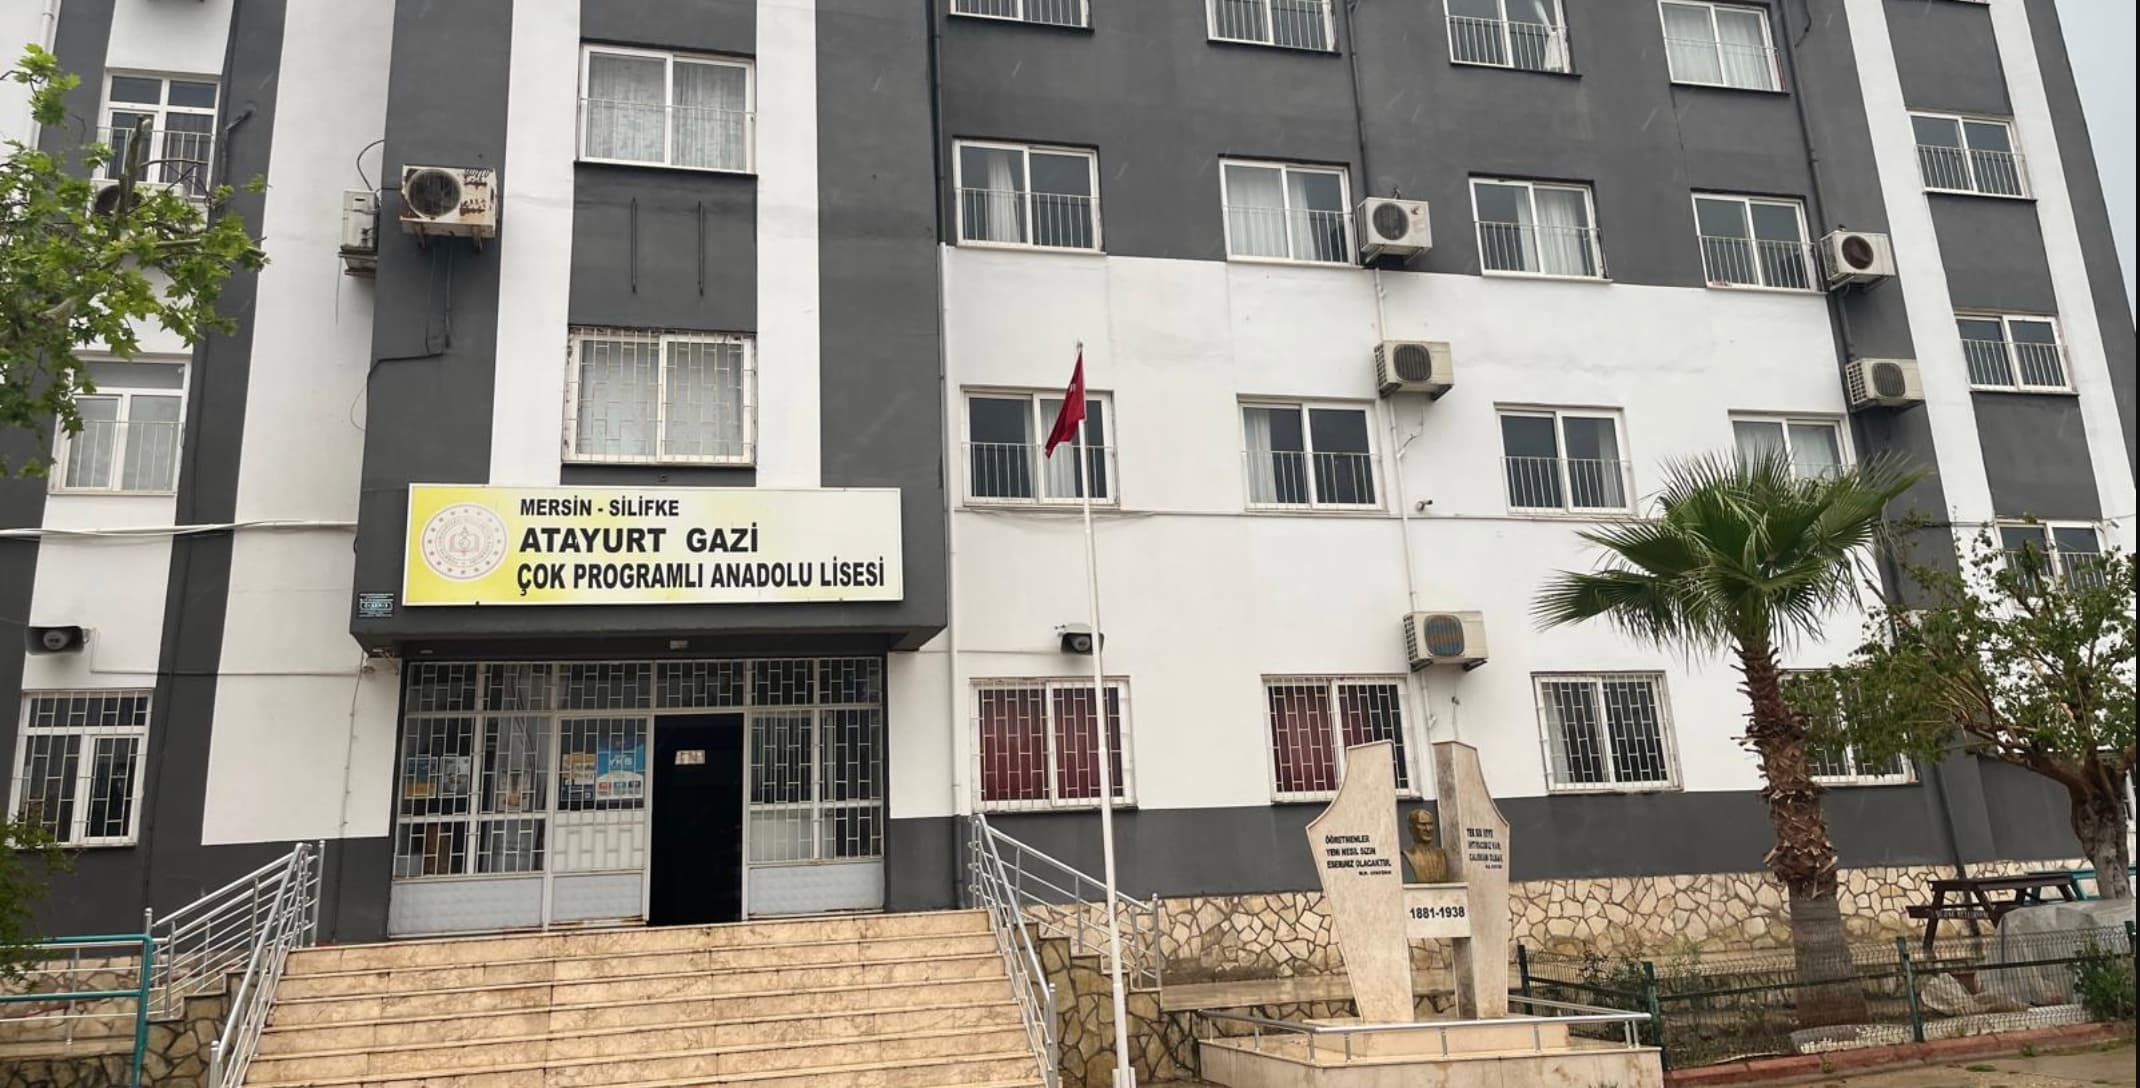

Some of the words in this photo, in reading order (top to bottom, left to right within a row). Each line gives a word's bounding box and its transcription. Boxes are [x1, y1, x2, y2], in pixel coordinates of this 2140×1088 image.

[520, 495, 592, 516] MERSİN
[609, 495, 680, 516] SİLİFKE
[519, 527, 667, 553] ATAYURT
[686, 522, 758, 553] GAZİ
[517, 563, 566, 596] ÇOK
[573, 562, 703, 589] PROGRAMLI
[710, 562, 813, 588] ANADOLU
[820, 556, 884, 587] LİSESİ
[1409, 906, 1465, 920] 1881-1938
